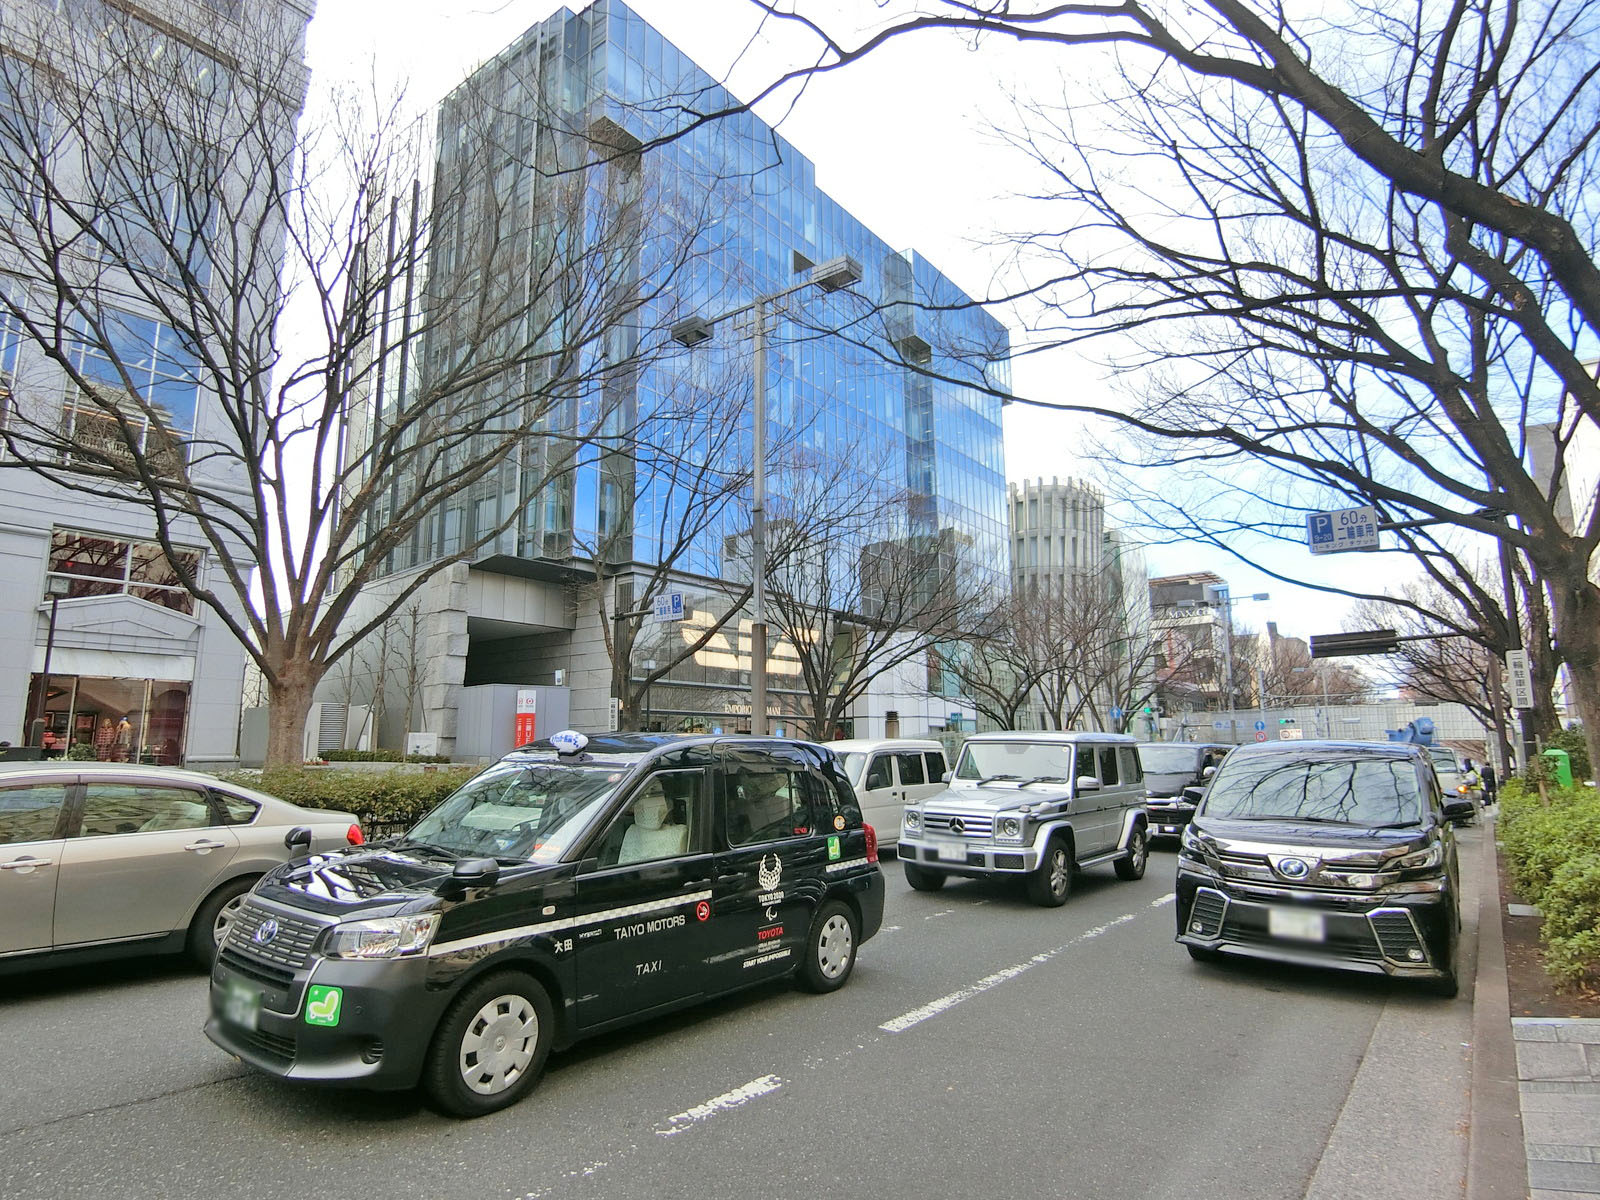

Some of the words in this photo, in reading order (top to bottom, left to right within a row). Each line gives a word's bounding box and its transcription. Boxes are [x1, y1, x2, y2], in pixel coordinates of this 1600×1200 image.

[1316, 517, 1328, 533] P
[1337, 523, 1374, 540] 二輪車用
[674, 595, 680, 608] P
[724, 703, 752, 715] EMPORIO
[614, 923, 645, 940] TAIYO
[646, 914, 686, 934] MOTORS
[757, 926, 784, 940] TOYOTA
[554, 938, 573, 954] 大田
[636, 959, 662, 976] TAXI
